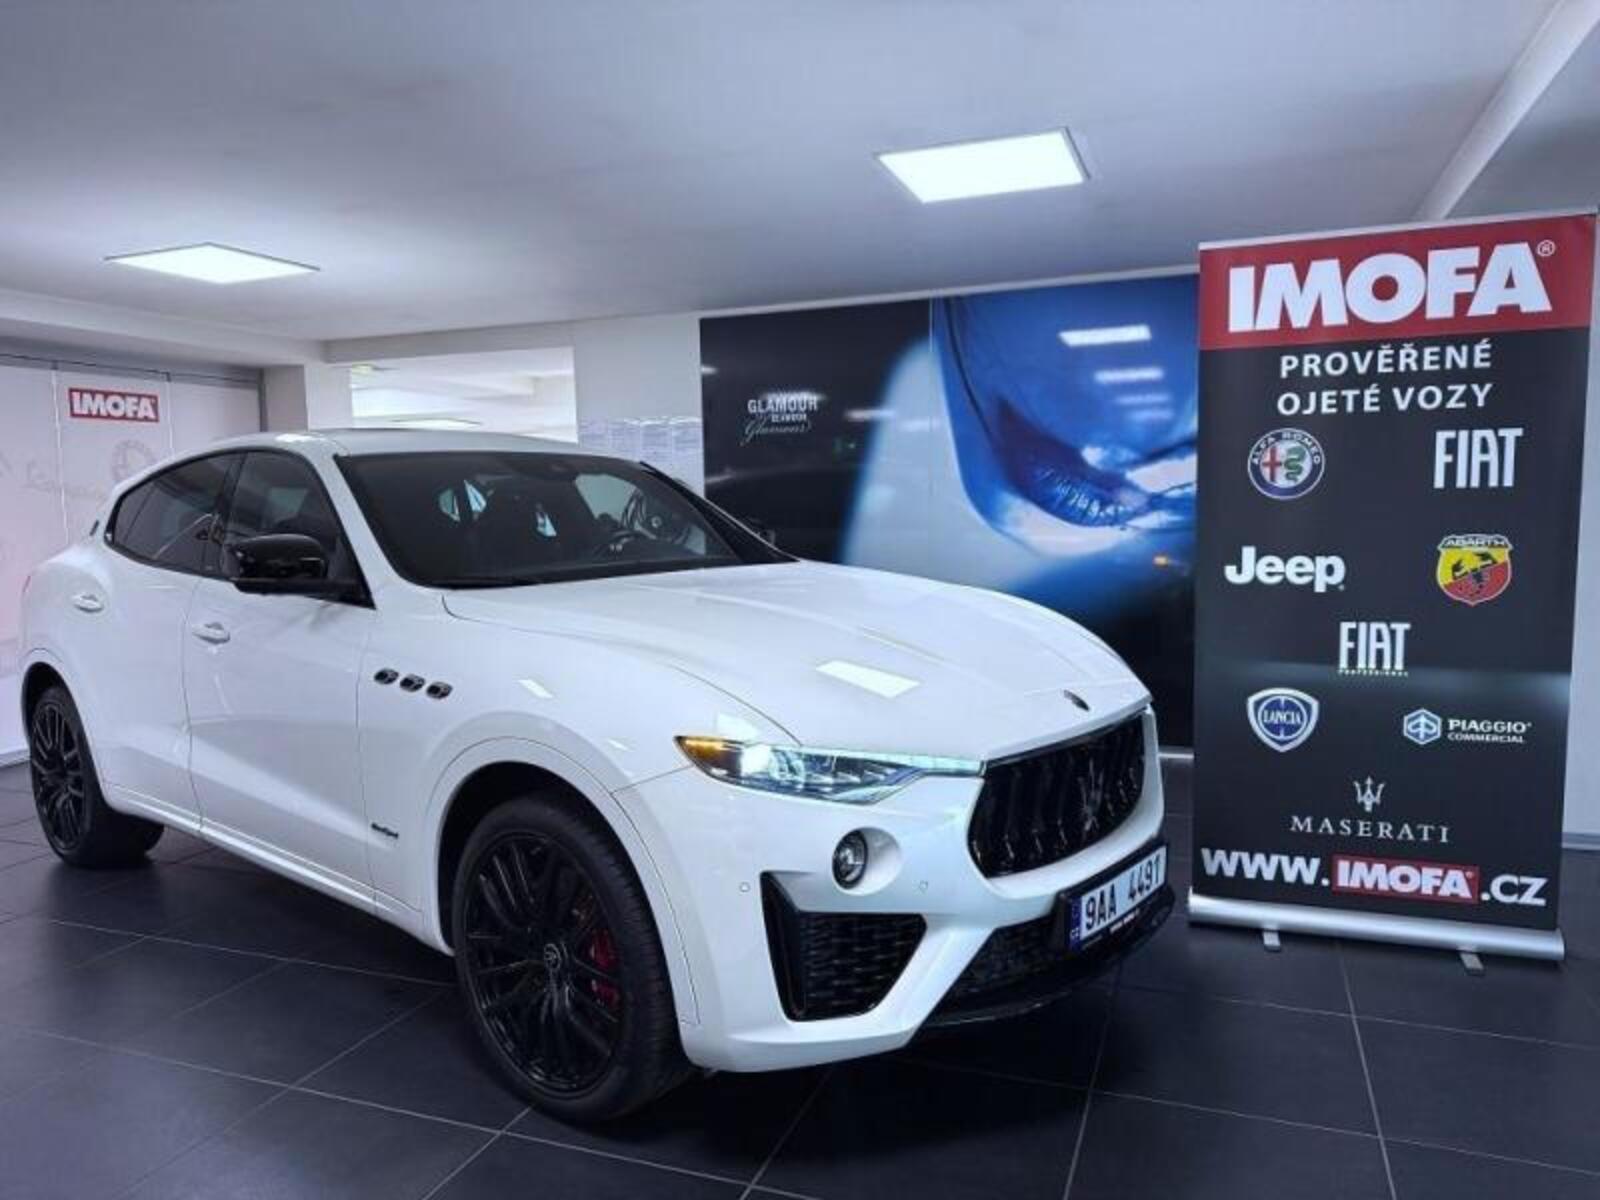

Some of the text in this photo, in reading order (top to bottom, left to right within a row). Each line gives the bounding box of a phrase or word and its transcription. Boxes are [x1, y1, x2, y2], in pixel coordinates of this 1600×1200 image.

[1228, 243, 1553, 333] IMOFA
[1279, 339, 1493, 379] PROVĚŘENÉ
[71, 391, 156, 420] IMOFA
[747, 395, 818, 414] GLAMOUR
[1276, 383, 1493, 417] OJETÉ VOZY
[1433, 428, 1524, 490] FIAT
[1224, 546, 1346, 593] Jeep
[1339, 621, 1412, 671] FIAT
[1263, 709, 1305, 725] LANCIA
[1447, 718, 1528, 734] PIAGGIO
[1447, 731, 1526, 744] COMMERCIAL
[1289, 815, 1450, 844] MASERATI
[1085, 883, 1117, 931] 9AA
[1128, 853, 1161, 901] 4491
